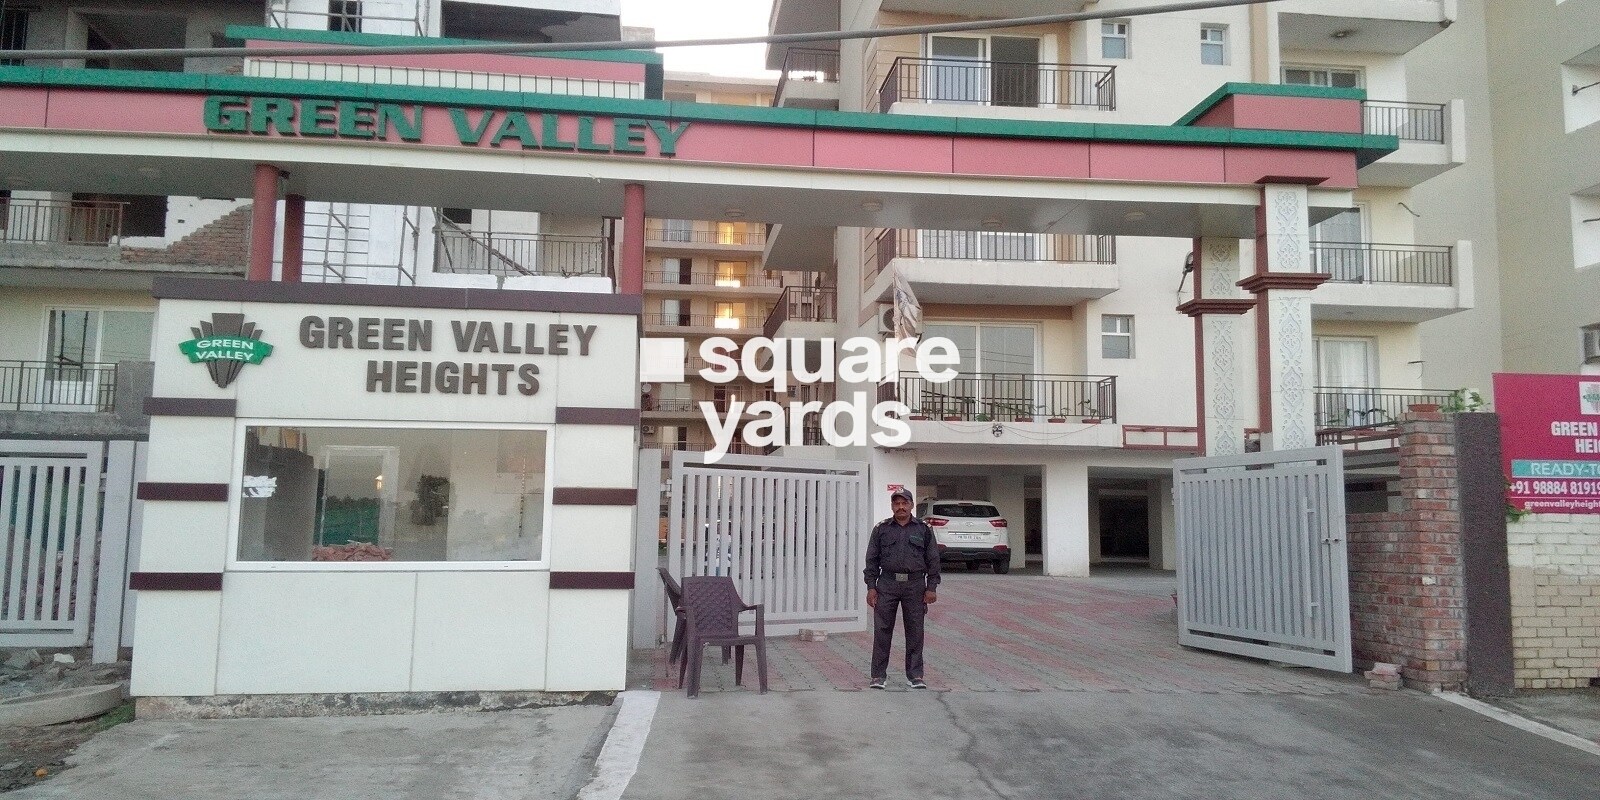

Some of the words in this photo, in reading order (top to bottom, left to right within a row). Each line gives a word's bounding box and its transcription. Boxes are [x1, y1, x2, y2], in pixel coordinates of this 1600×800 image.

[203, 95, 423, 142] GREEN
[447, 108, 692, 158] VALLEY
[300, 315, 433, 352] GREEN
[450, 320, 597, 356] VALLEY
[196, 339, 254, 350] GREEN
[196, 350, 254, 361] VALLEY
[366, 360, 540, 396] HEIGHTS
[1551, 421, 1598, 437] GREEN
[1575, 438, 1600, 453] HEI
[1509, 480, 1530, 494] +91
